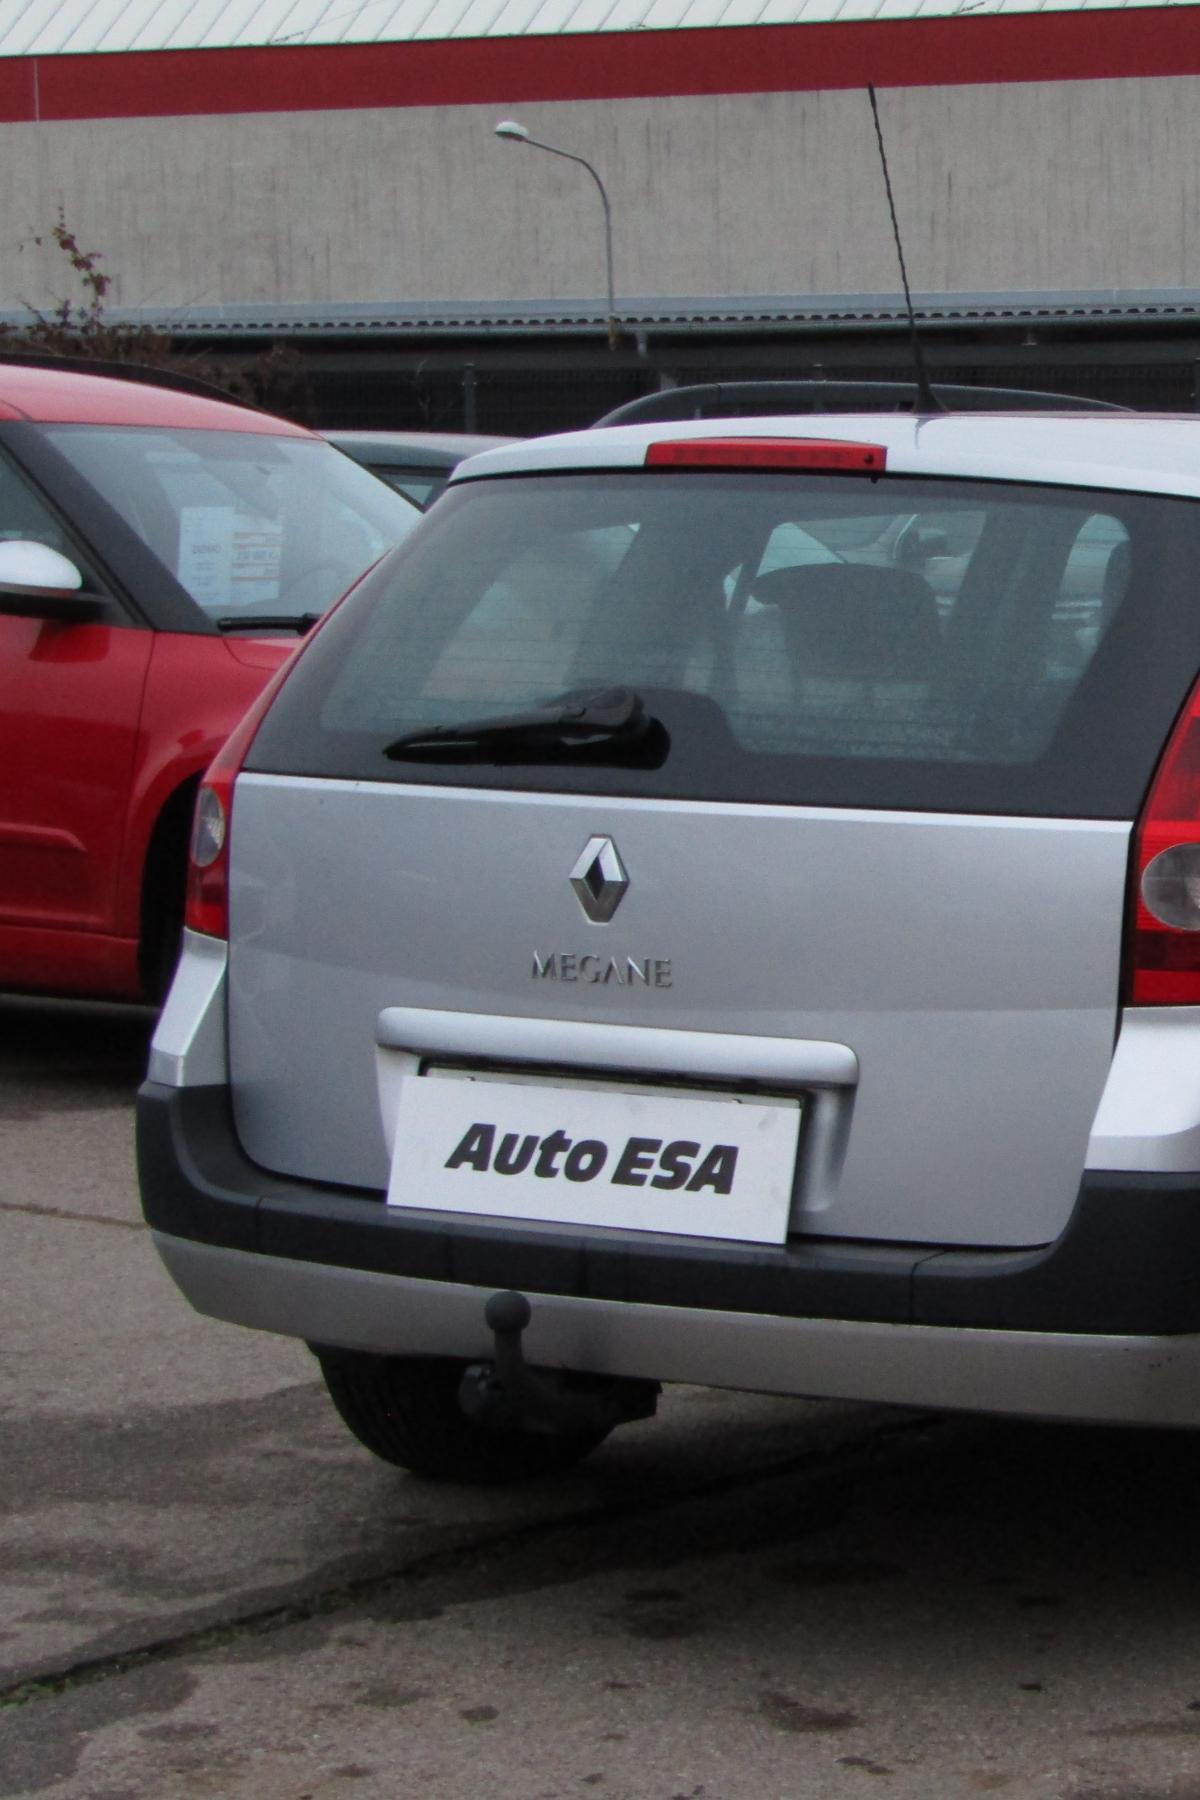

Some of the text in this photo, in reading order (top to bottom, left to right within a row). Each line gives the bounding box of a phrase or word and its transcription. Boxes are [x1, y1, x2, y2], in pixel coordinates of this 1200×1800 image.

[531, 949, 673, 988] MEGANE
[444, 1122, 740, 1195] Auto ESA
